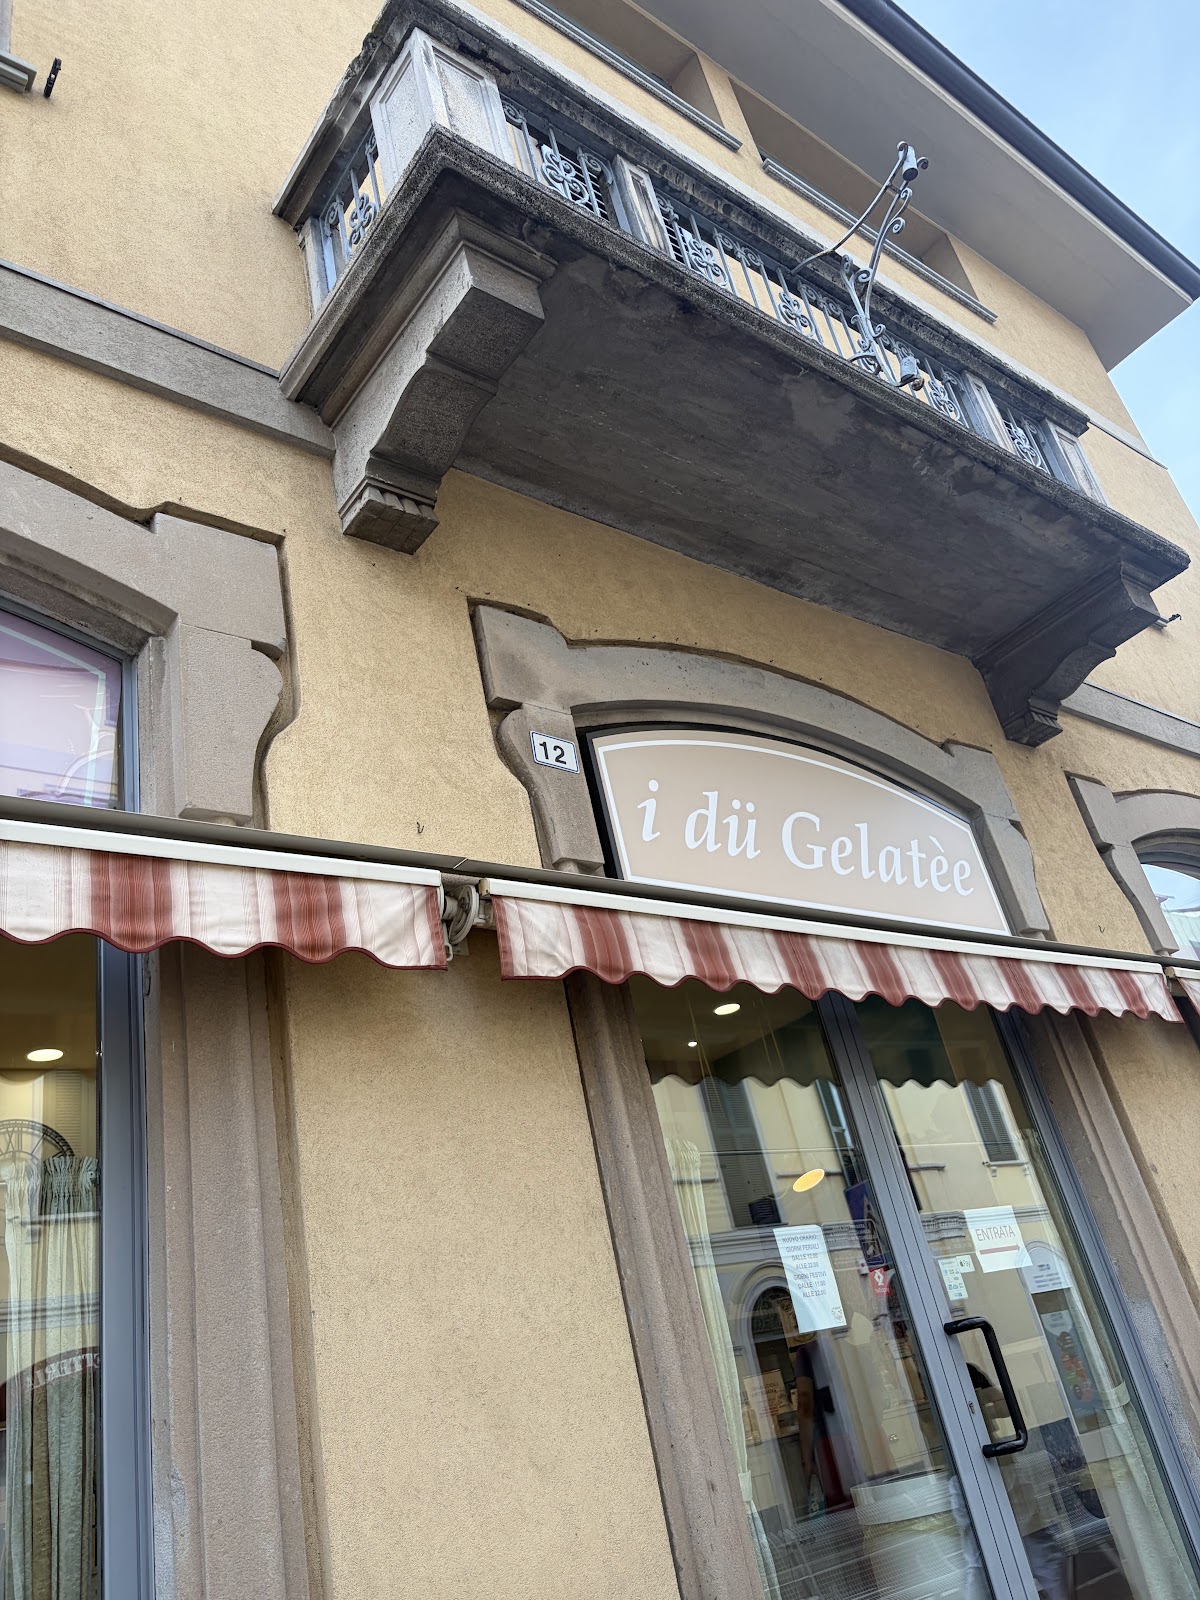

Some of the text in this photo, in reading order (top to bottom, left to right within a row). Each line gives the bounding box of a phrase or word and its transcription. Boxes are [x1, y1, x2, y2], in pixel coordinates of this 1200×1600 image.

[539, 741, 567, 765] 12
[637, 779, 974, 896] i dü Gelatèe
[975, 1225, 1016, 1241] ENTRATA
[786, 1244, 820, 1253] GIORNI FERIALI
[810, 1271, 827, 1279] FESTIVI
[798, 1282, 813, 1290] DALLE
